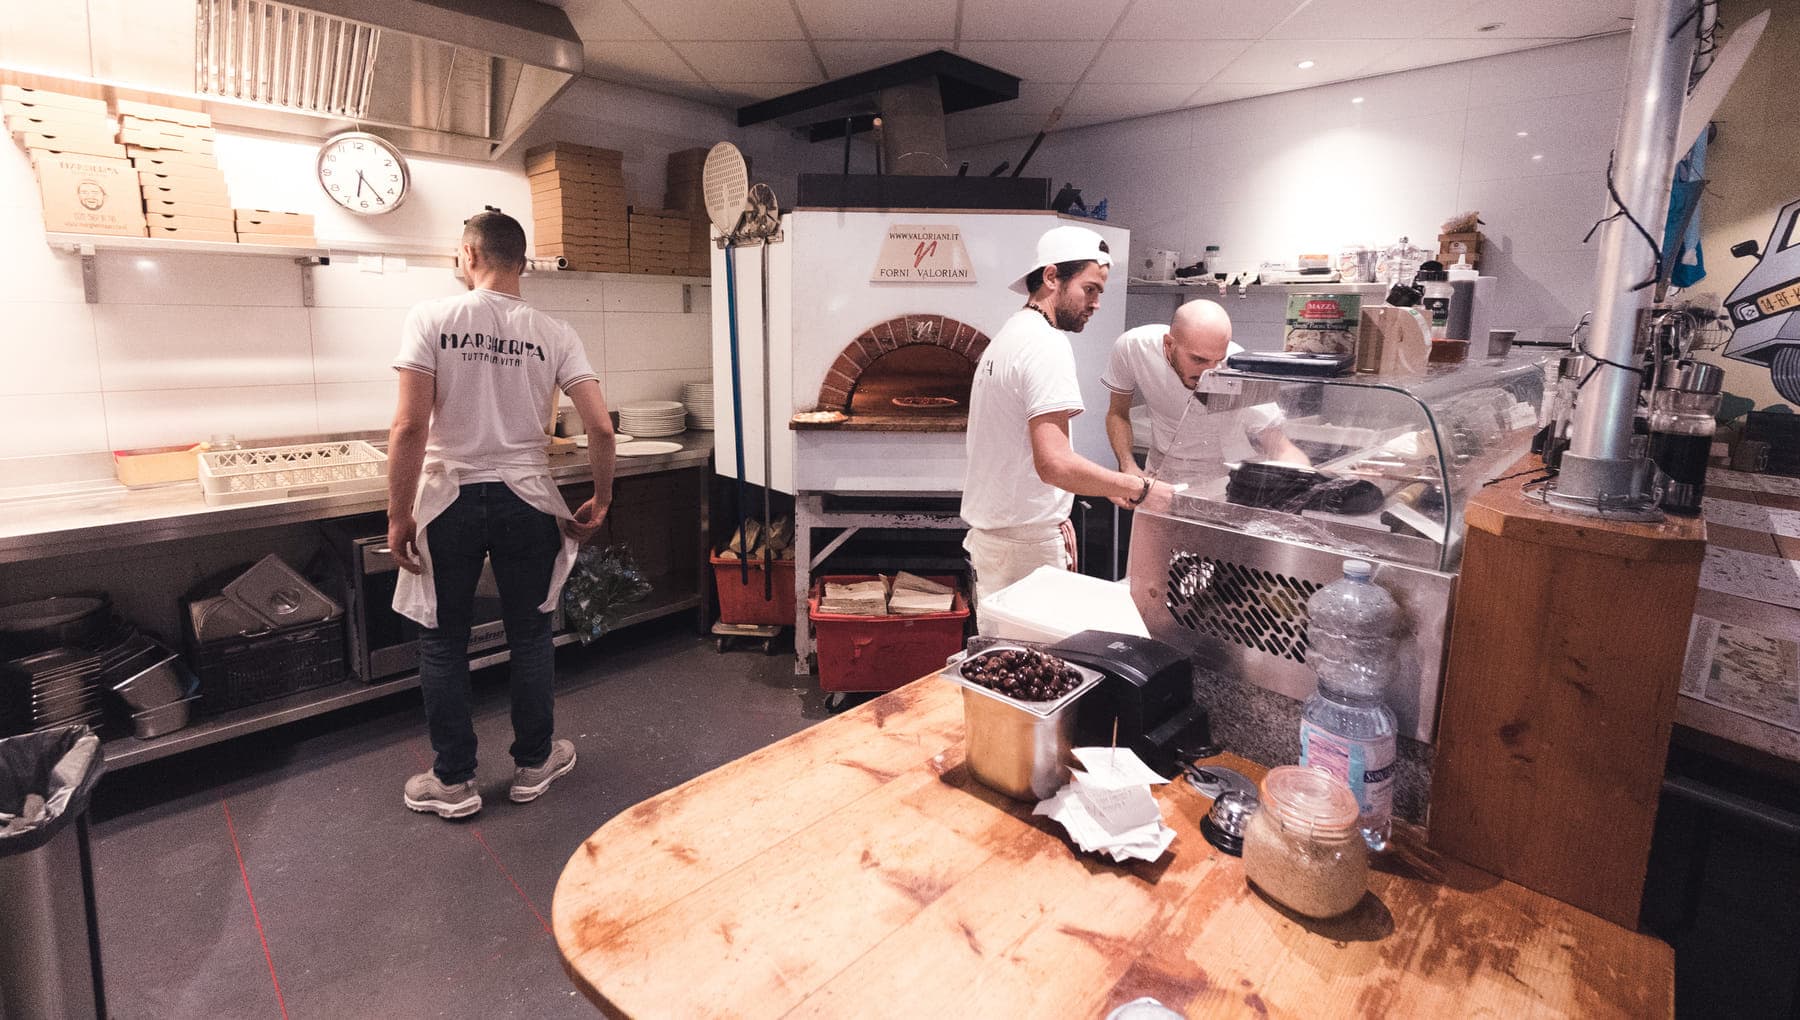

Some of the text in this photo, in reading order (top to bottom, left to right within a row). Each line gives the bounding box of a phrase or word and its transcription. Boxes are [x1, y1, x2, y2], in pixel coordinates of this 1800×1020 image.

[353, 142, 364, 150] 12
[327, 154, 336, 162] 10
[384, 159, 392, 167] 2
[322, 168, 332, 176] 9
[390, 174, 399, 182] 3
[331, 184, 340, 192] 8
[387, 187, 394, 195] 4
[344, 195, 351, 203] 7
[360, 200, 369, 208] 6
[880, 268, 968, 279] FORNI VALORIANI
[440, 333, 545, 361] MARGHERITA
[462, 352, 489, 361] TUTTA
